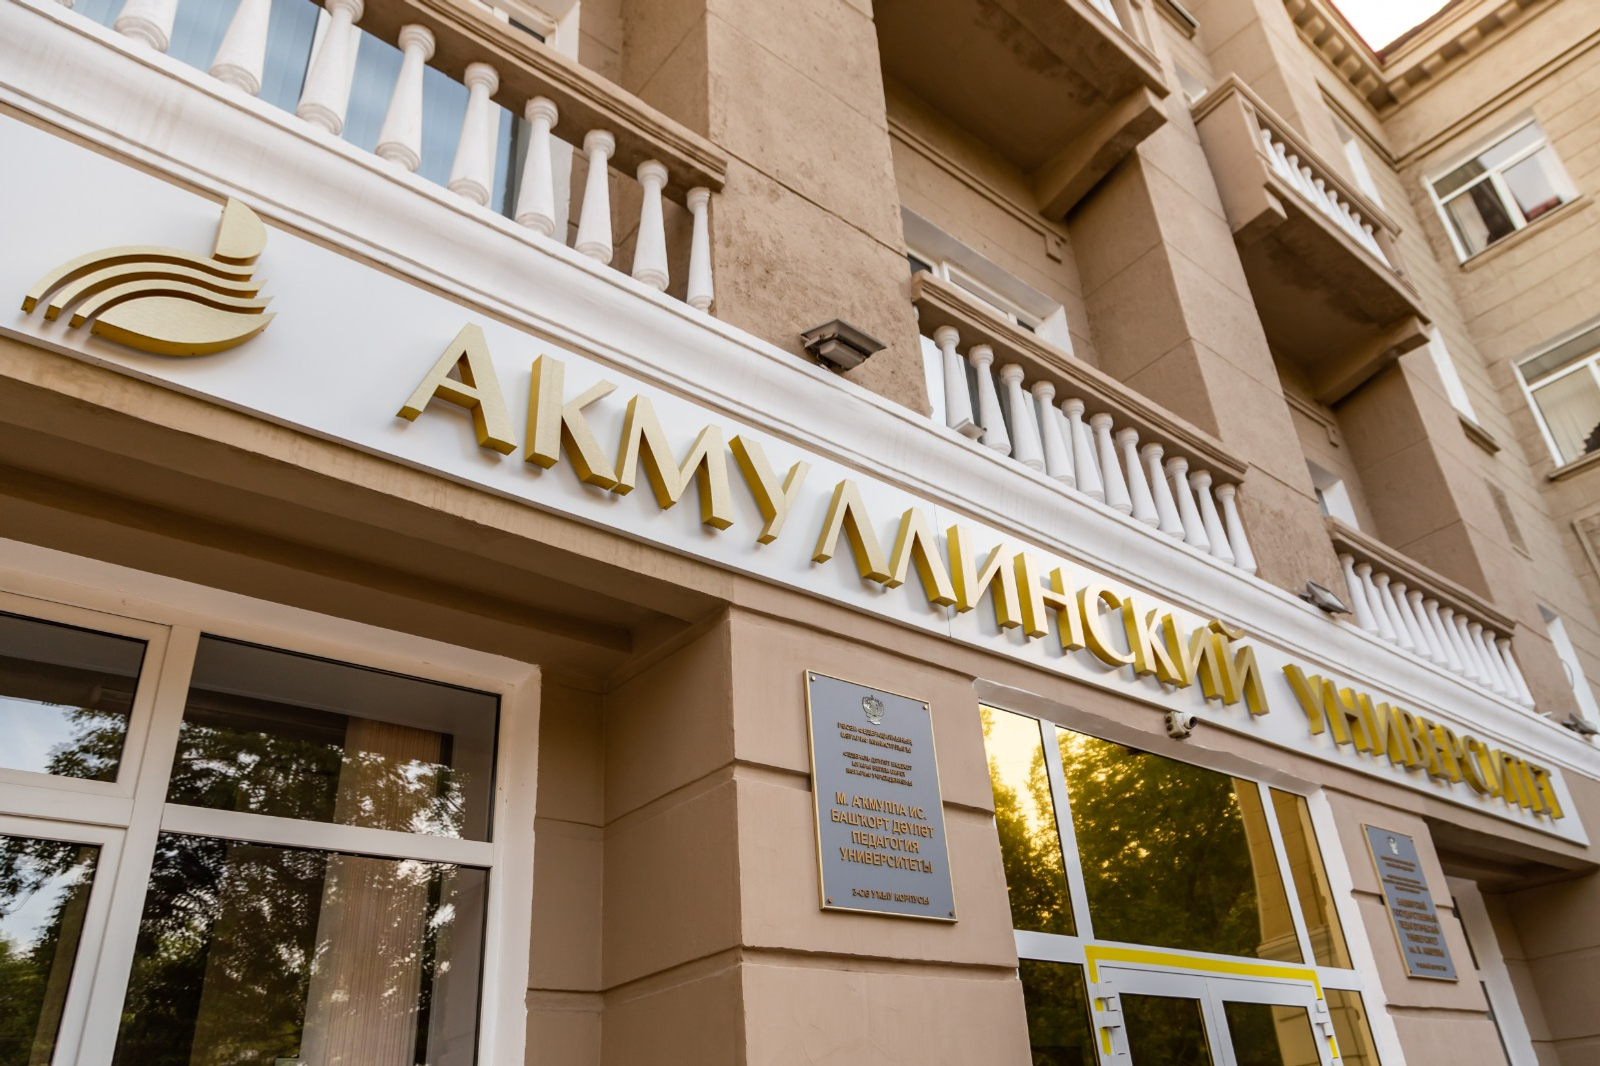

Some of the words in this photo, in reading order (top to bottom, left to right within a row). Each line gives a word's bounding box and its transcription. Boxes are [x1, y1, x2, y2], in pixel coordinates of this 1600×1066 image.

[396, 322, 1269, 716] АКМУЛЛИНСКИЙ
[1282, 664, 1565, 819] УНИВЕРСИТЕТ
[836, 791, 848, 806] М.
[909, 805, 926, 820] ИС.
[852, 830, 920, 853] ПЕДАГОГИЯ
[840, 847, 933, 873] УНИВЕРСИТЕТЫ
